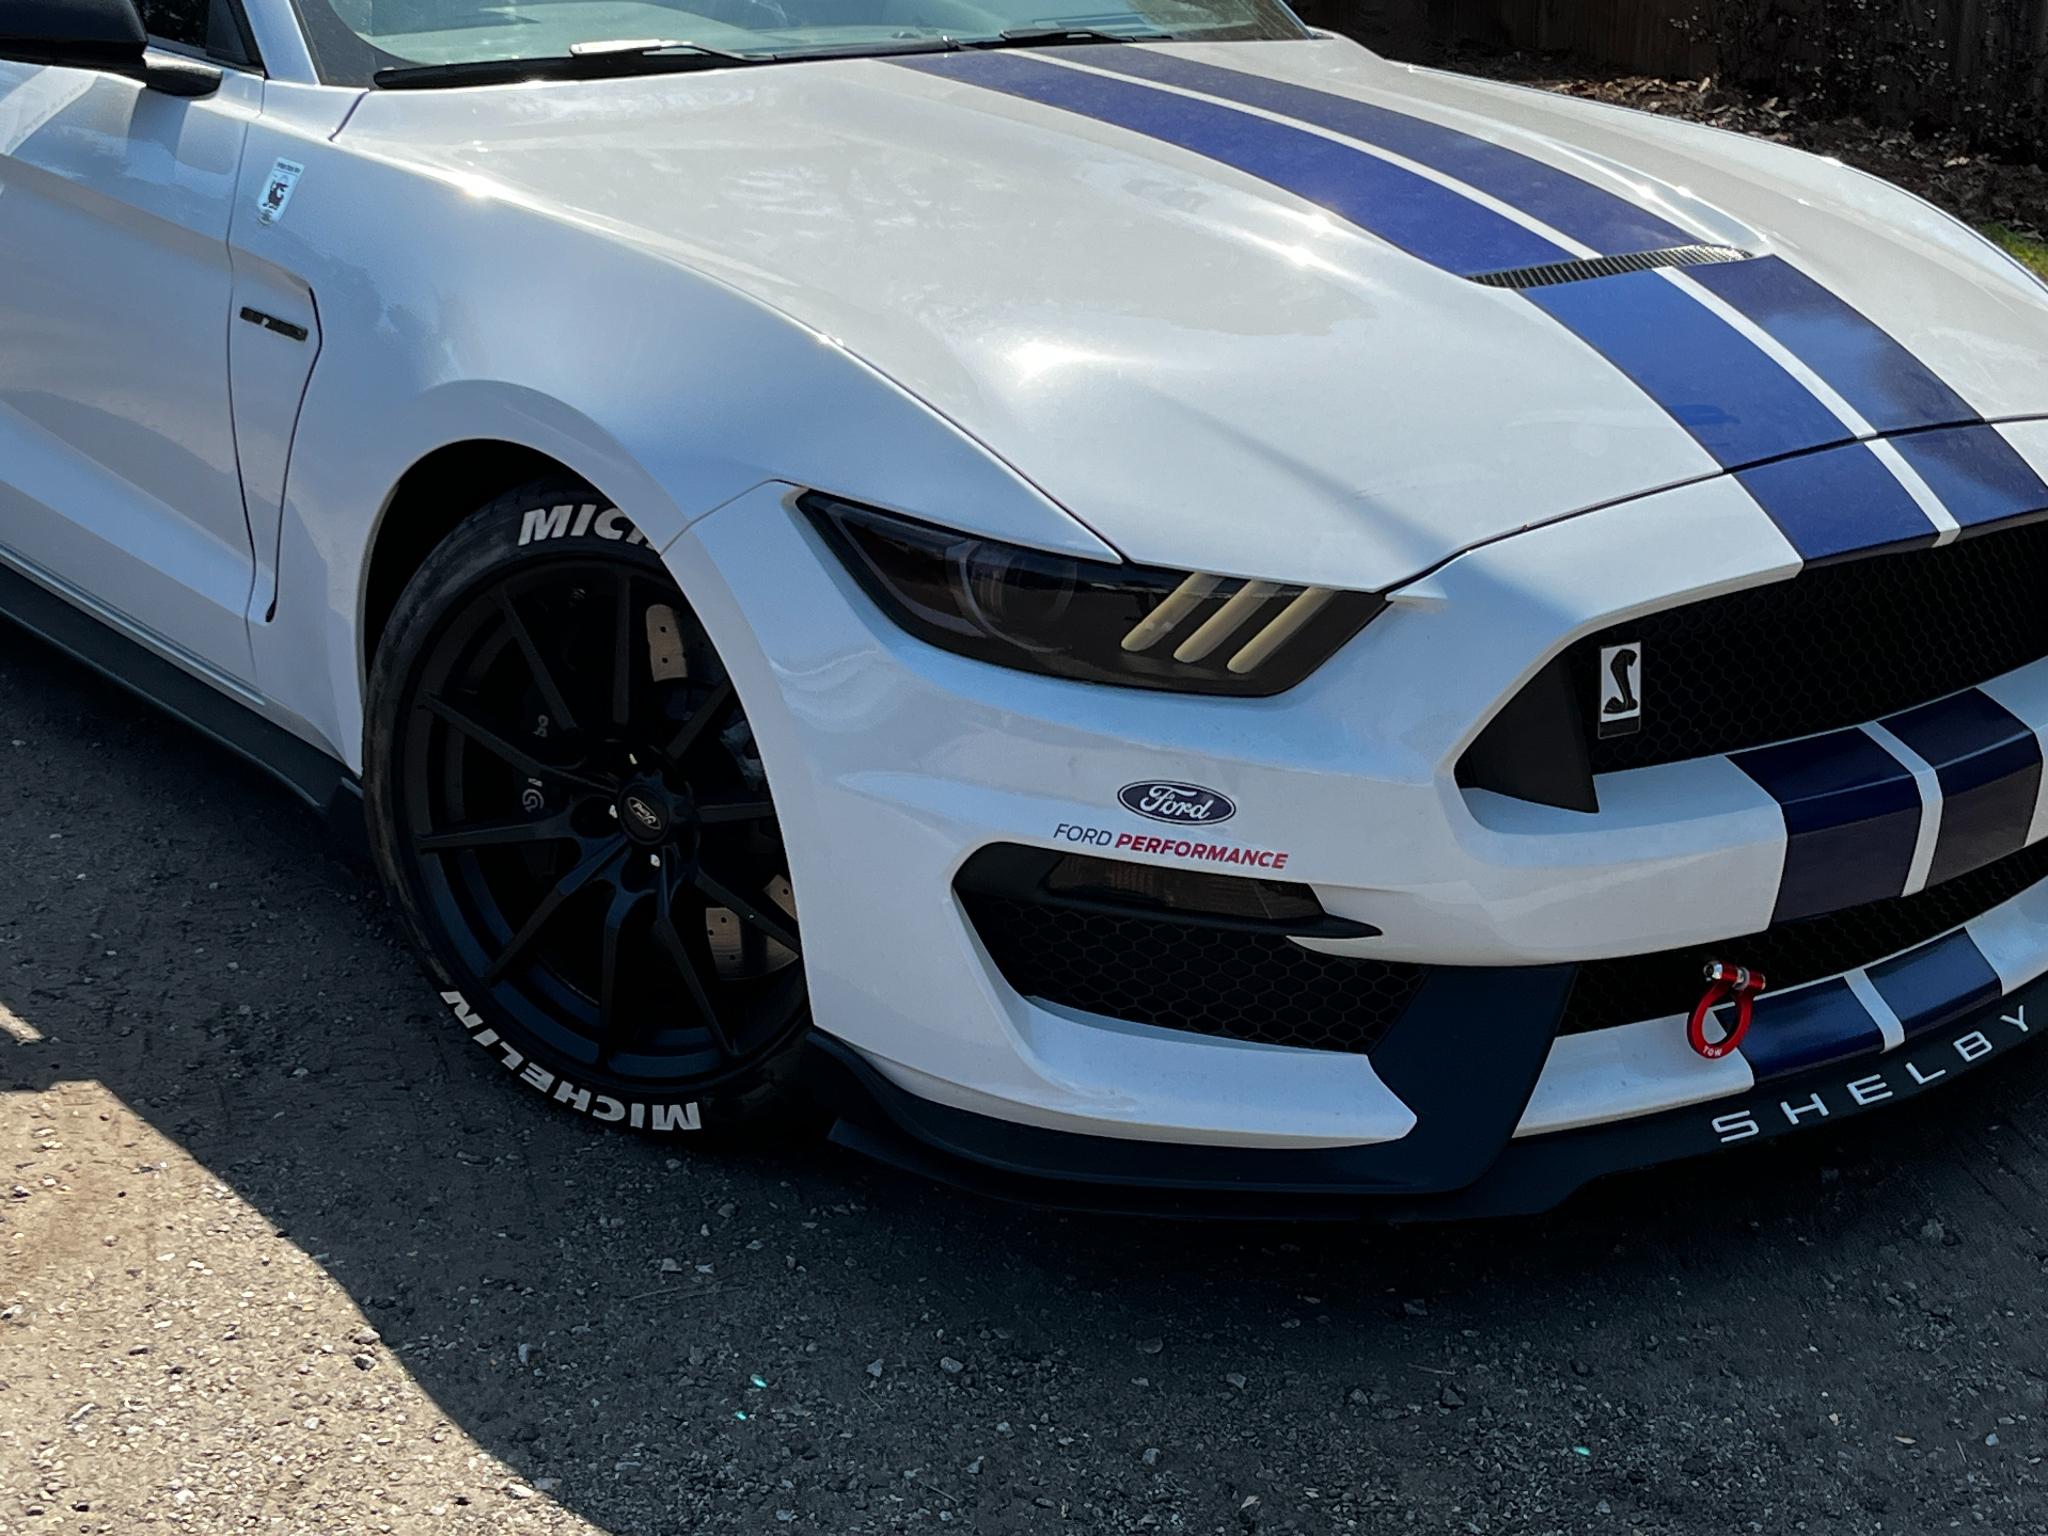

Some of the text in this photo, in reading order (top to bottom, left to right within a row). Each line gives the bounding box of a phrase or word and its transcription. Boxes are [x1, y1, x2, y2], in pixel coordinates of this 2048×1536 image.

[1140, 785, 1215, 820] Ford
[1053, 823, 1289, 869] FORD PERFORMANCE
[440, 991, 702, 1130] MICHELIN
[1703, 1045, 1723, 1057] TOW
[1711, 1004, 2029, 1143] SHELBY
